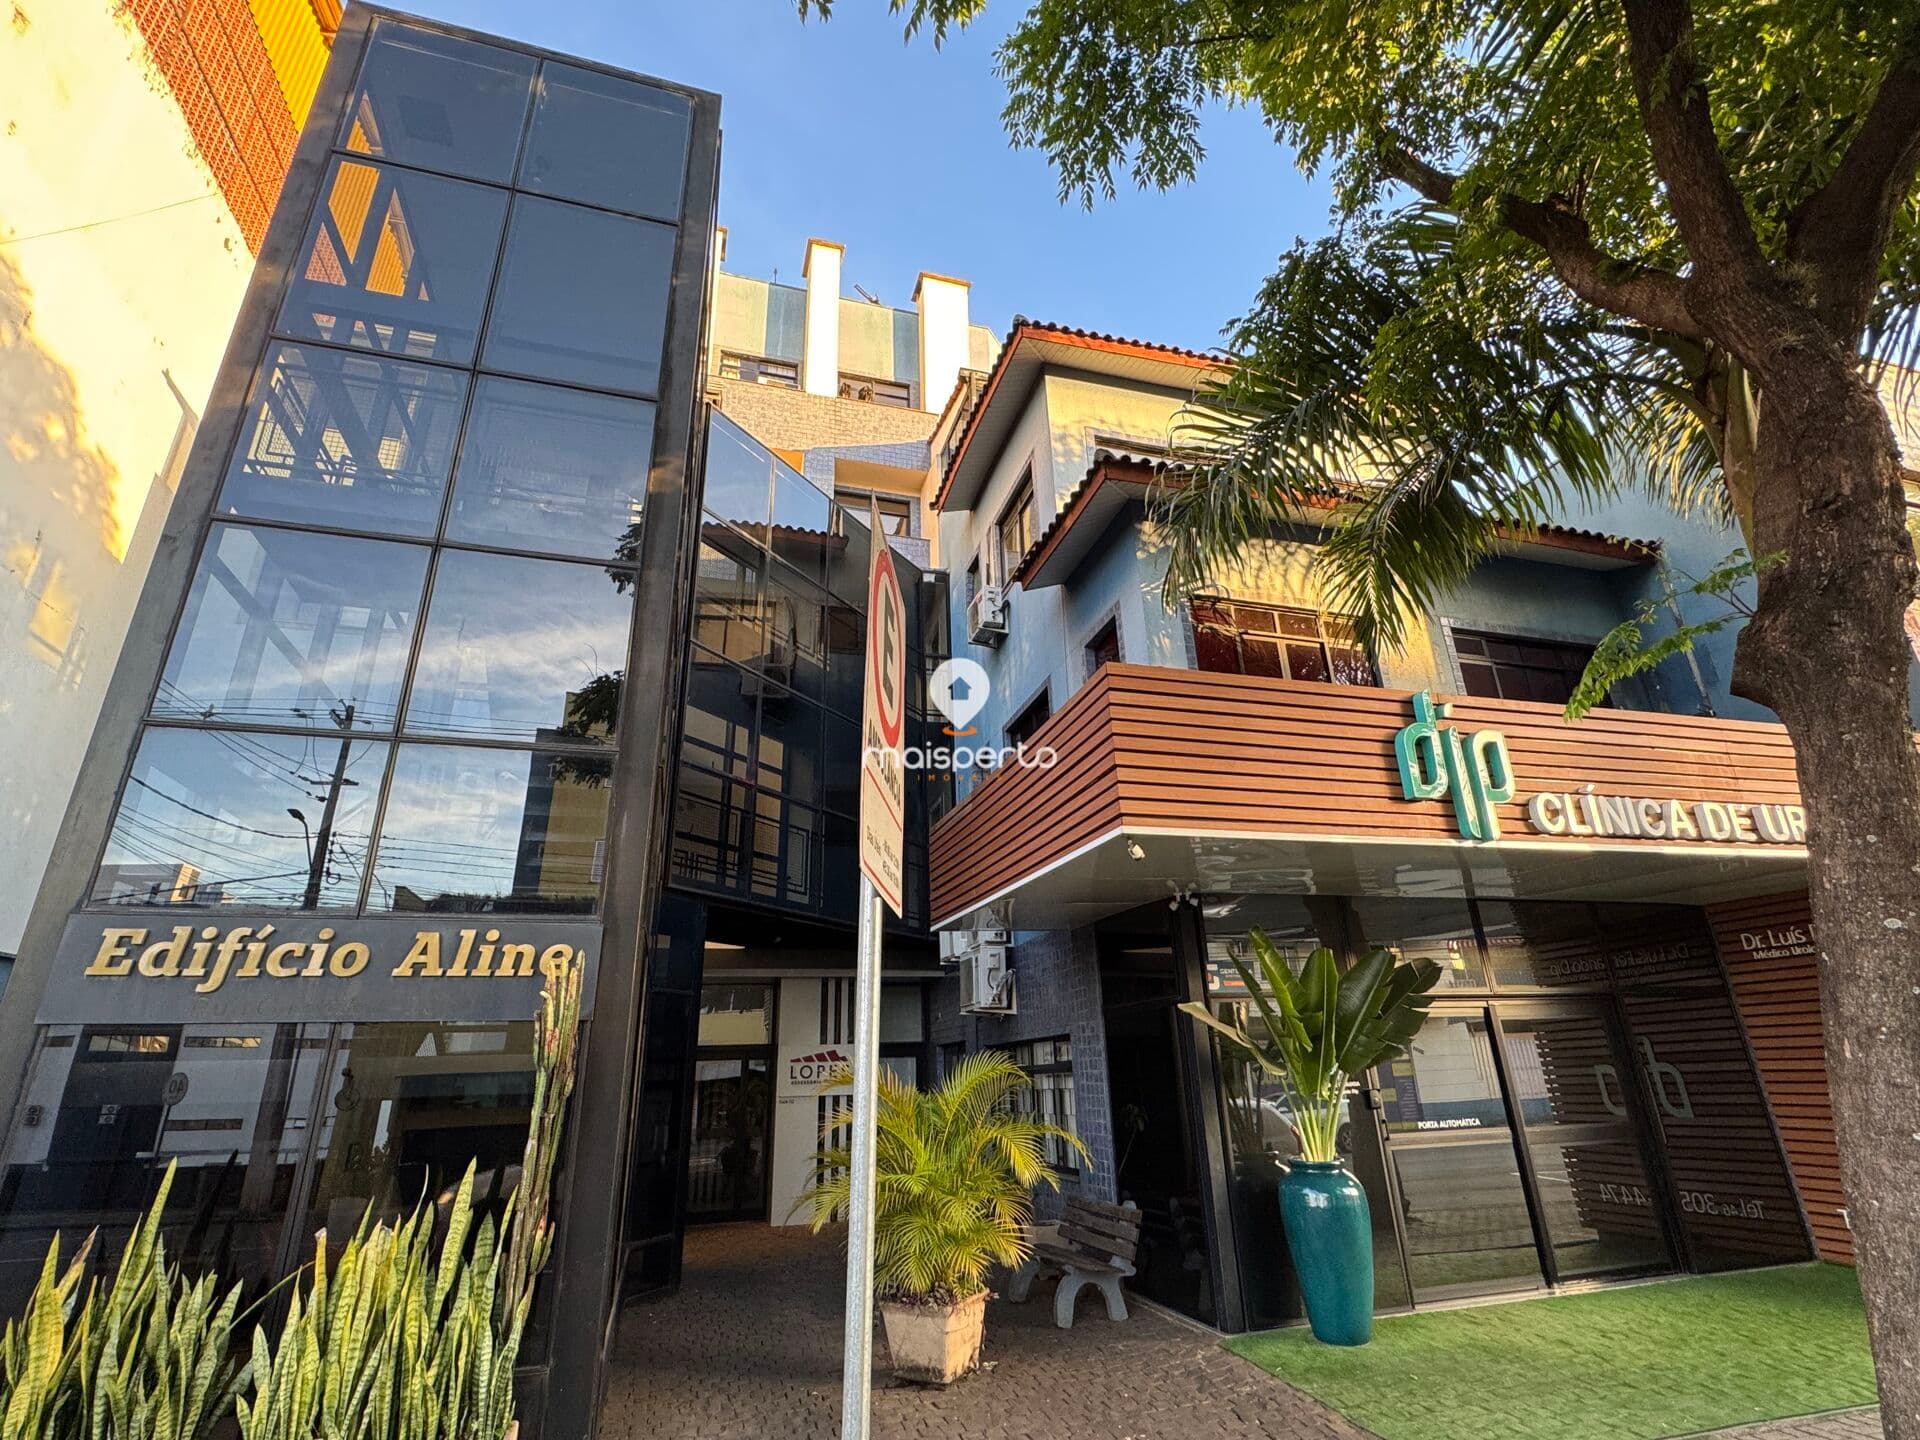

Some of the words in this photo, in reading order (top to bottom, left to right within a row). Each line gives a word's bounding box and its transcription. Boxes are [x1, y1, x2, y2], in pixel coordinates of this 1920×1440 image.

[1529, 784, 1698, 839] CLÍNICA
[1694, 802, 1757, 842] DE
[84, 924, 371, 994] Edifício
[391, 927, 577, 978] Aline
[1740, 932, 1767, 951] Dr.
[1767, 925, 1807, 947] Luís
[1417, 1120, 1439, 1130] PORTA
[1439, 1117, 1481, 1129] AUTOMÁTICA
